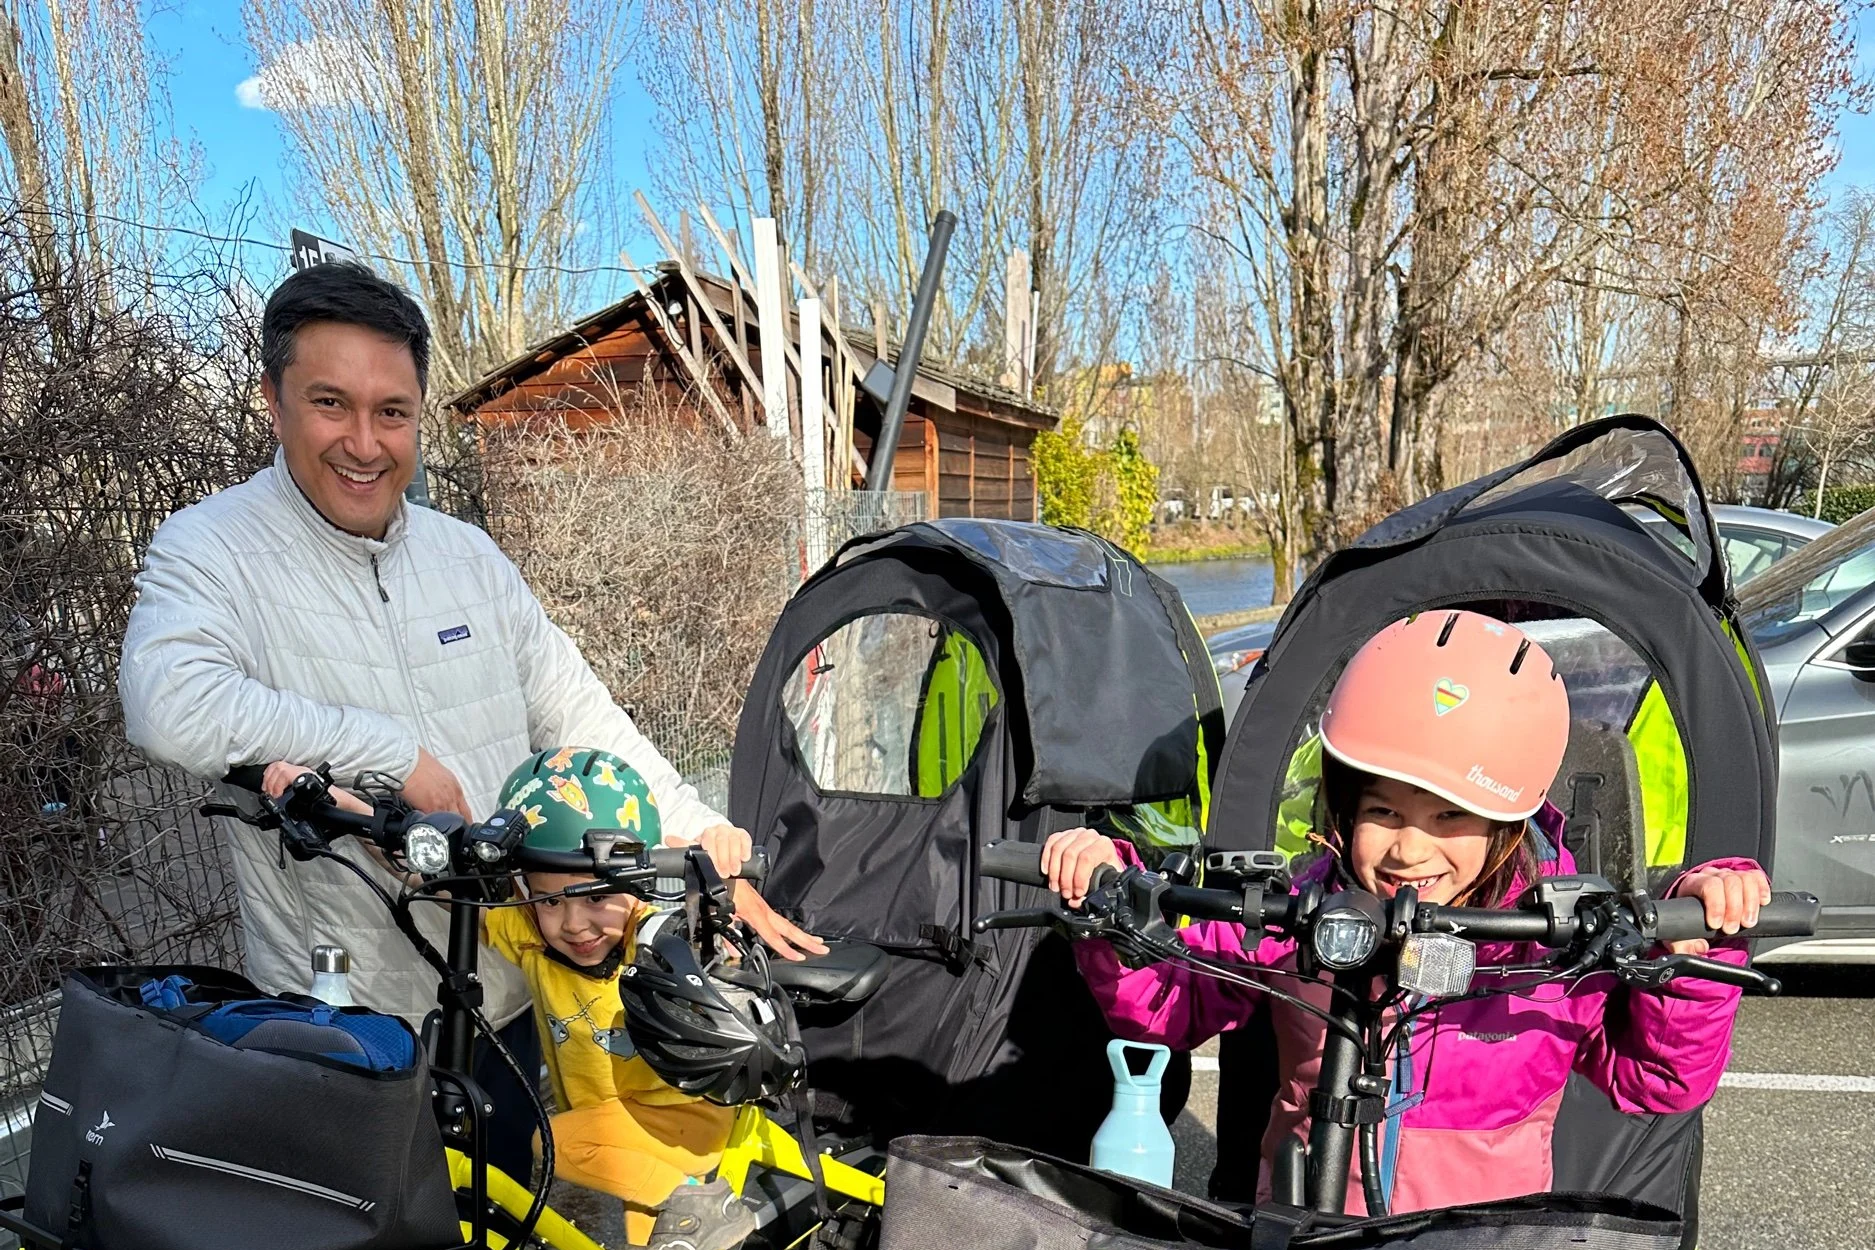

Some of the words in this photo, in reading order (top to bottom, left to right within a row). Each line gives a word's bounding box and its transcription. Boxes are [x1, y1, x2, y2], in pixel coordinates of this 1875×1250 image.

[1466, 764, 1525, 803] thousand
[1458, 1031, 1516, 1042] patagonia
[86, 1129, 104, 1146] tern
